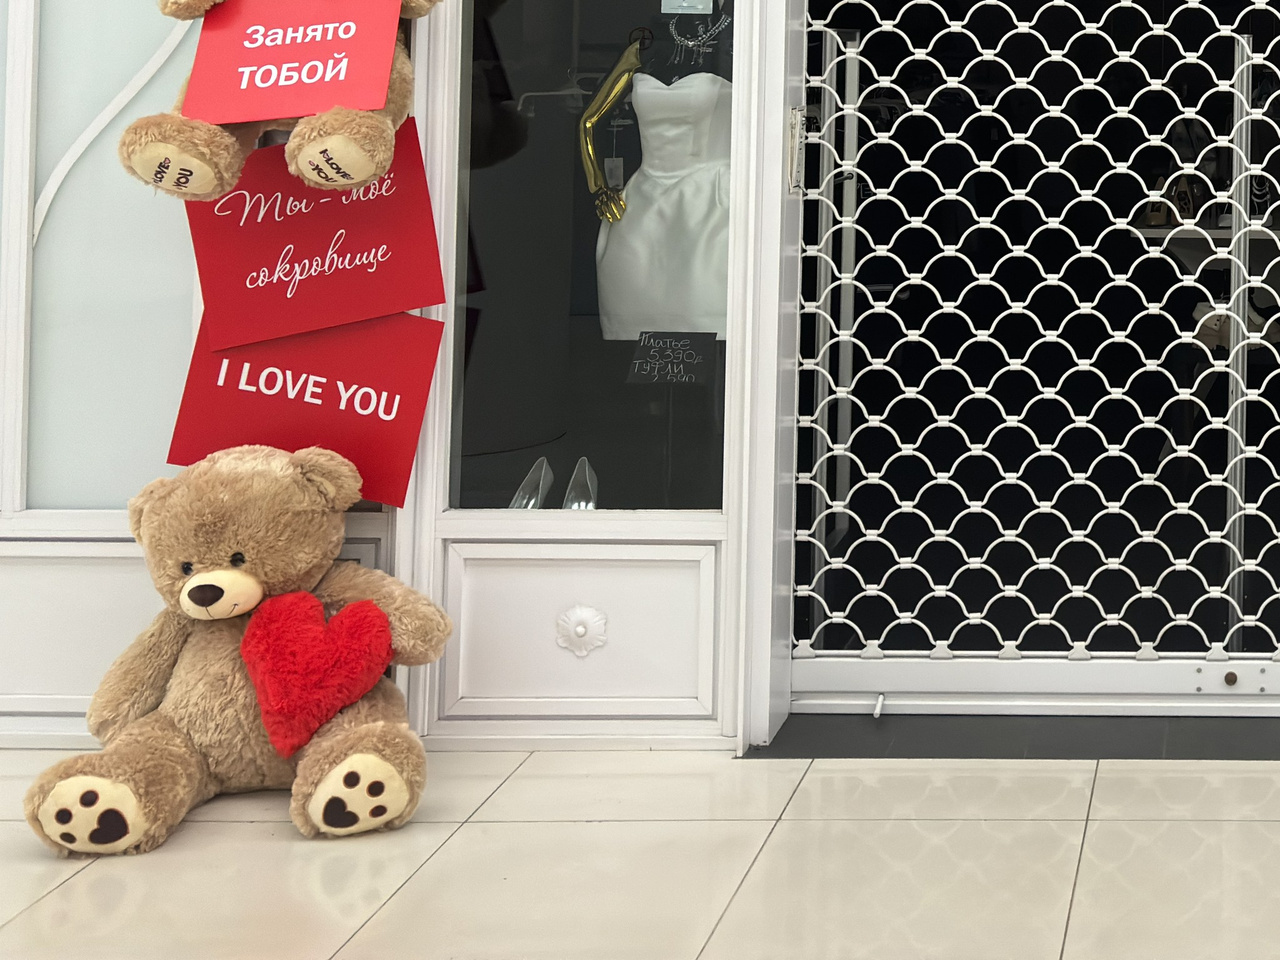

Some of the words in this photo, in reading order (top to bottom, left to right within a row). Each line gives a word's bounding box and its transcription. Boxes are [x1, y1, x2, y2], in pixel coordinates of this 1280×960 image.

[243, 21, 357, 48] Занято
[237, 52, 349, 90] ТОБОЙ
[172, 167, 194, 189] YOU
[312, 164, 338, 184] YOU
[325, 157, 351, 180] LOVE
[214, 190, 315, 227] Ты
[245, 228, 392, 299] сокровище
[639, 332, 691, 350] Платье
[216, 357, 230, 387] I
[238, 362, 328, 405] LOVE
[336, 380, 401, 421] YOU
